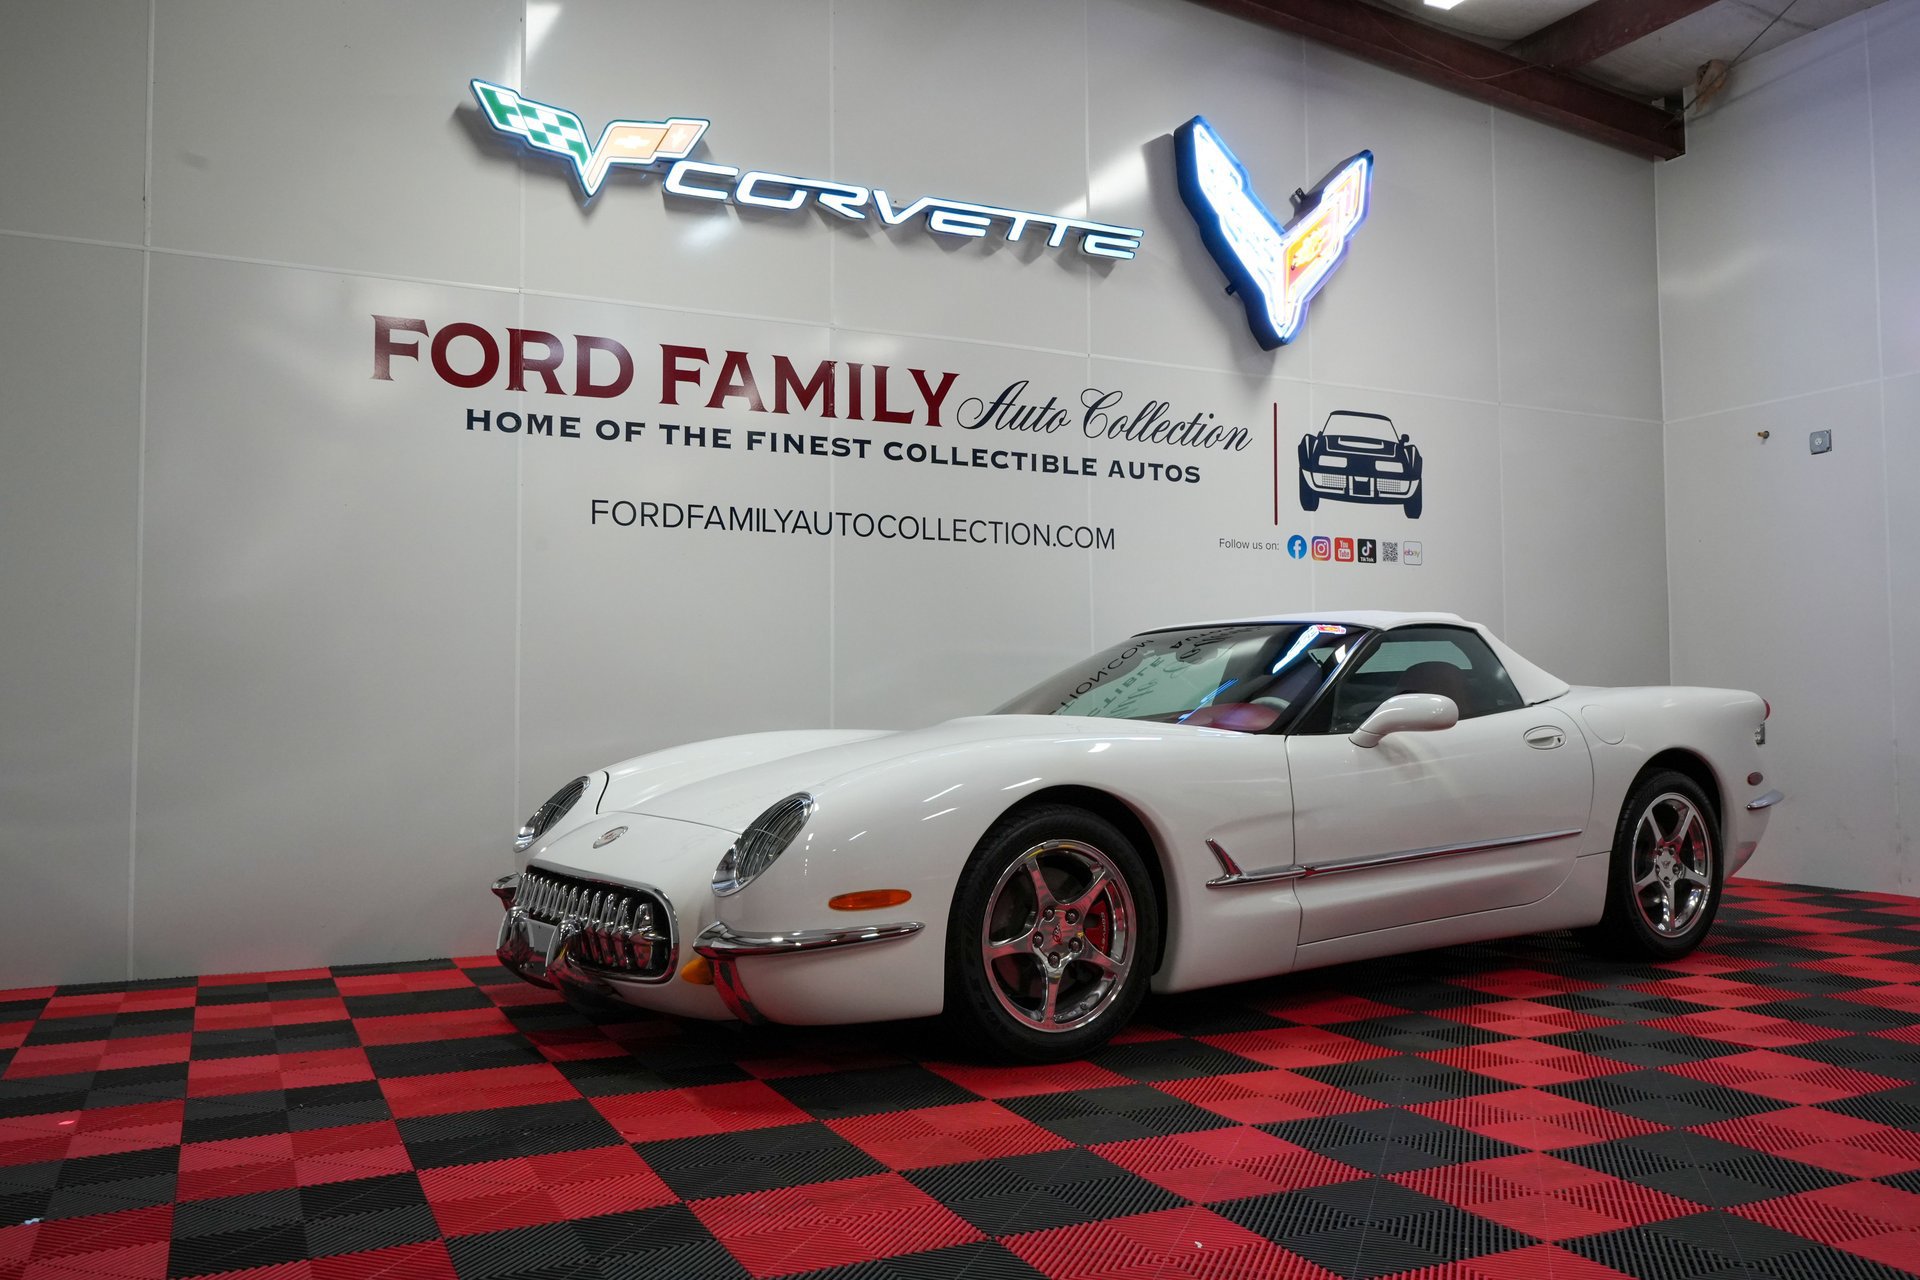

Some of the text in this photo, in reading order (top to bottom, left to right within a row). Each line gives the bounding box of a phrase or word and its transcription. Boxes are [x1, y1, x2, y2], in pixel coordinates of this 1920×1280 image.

[663, 159, 1145, 260] CORVETTE
[370, 314, 1253, 452] FORD FAMILY Auto Collection
[465, 408, 1201, 484] HOME OF THE FINEST COLLECTIBLE AUTOS
[590, 499, 1116, 550] FORDFAMILYAUTOCOLLECTION.COM
[1219, 538, 1280, 551] Follow us on:
